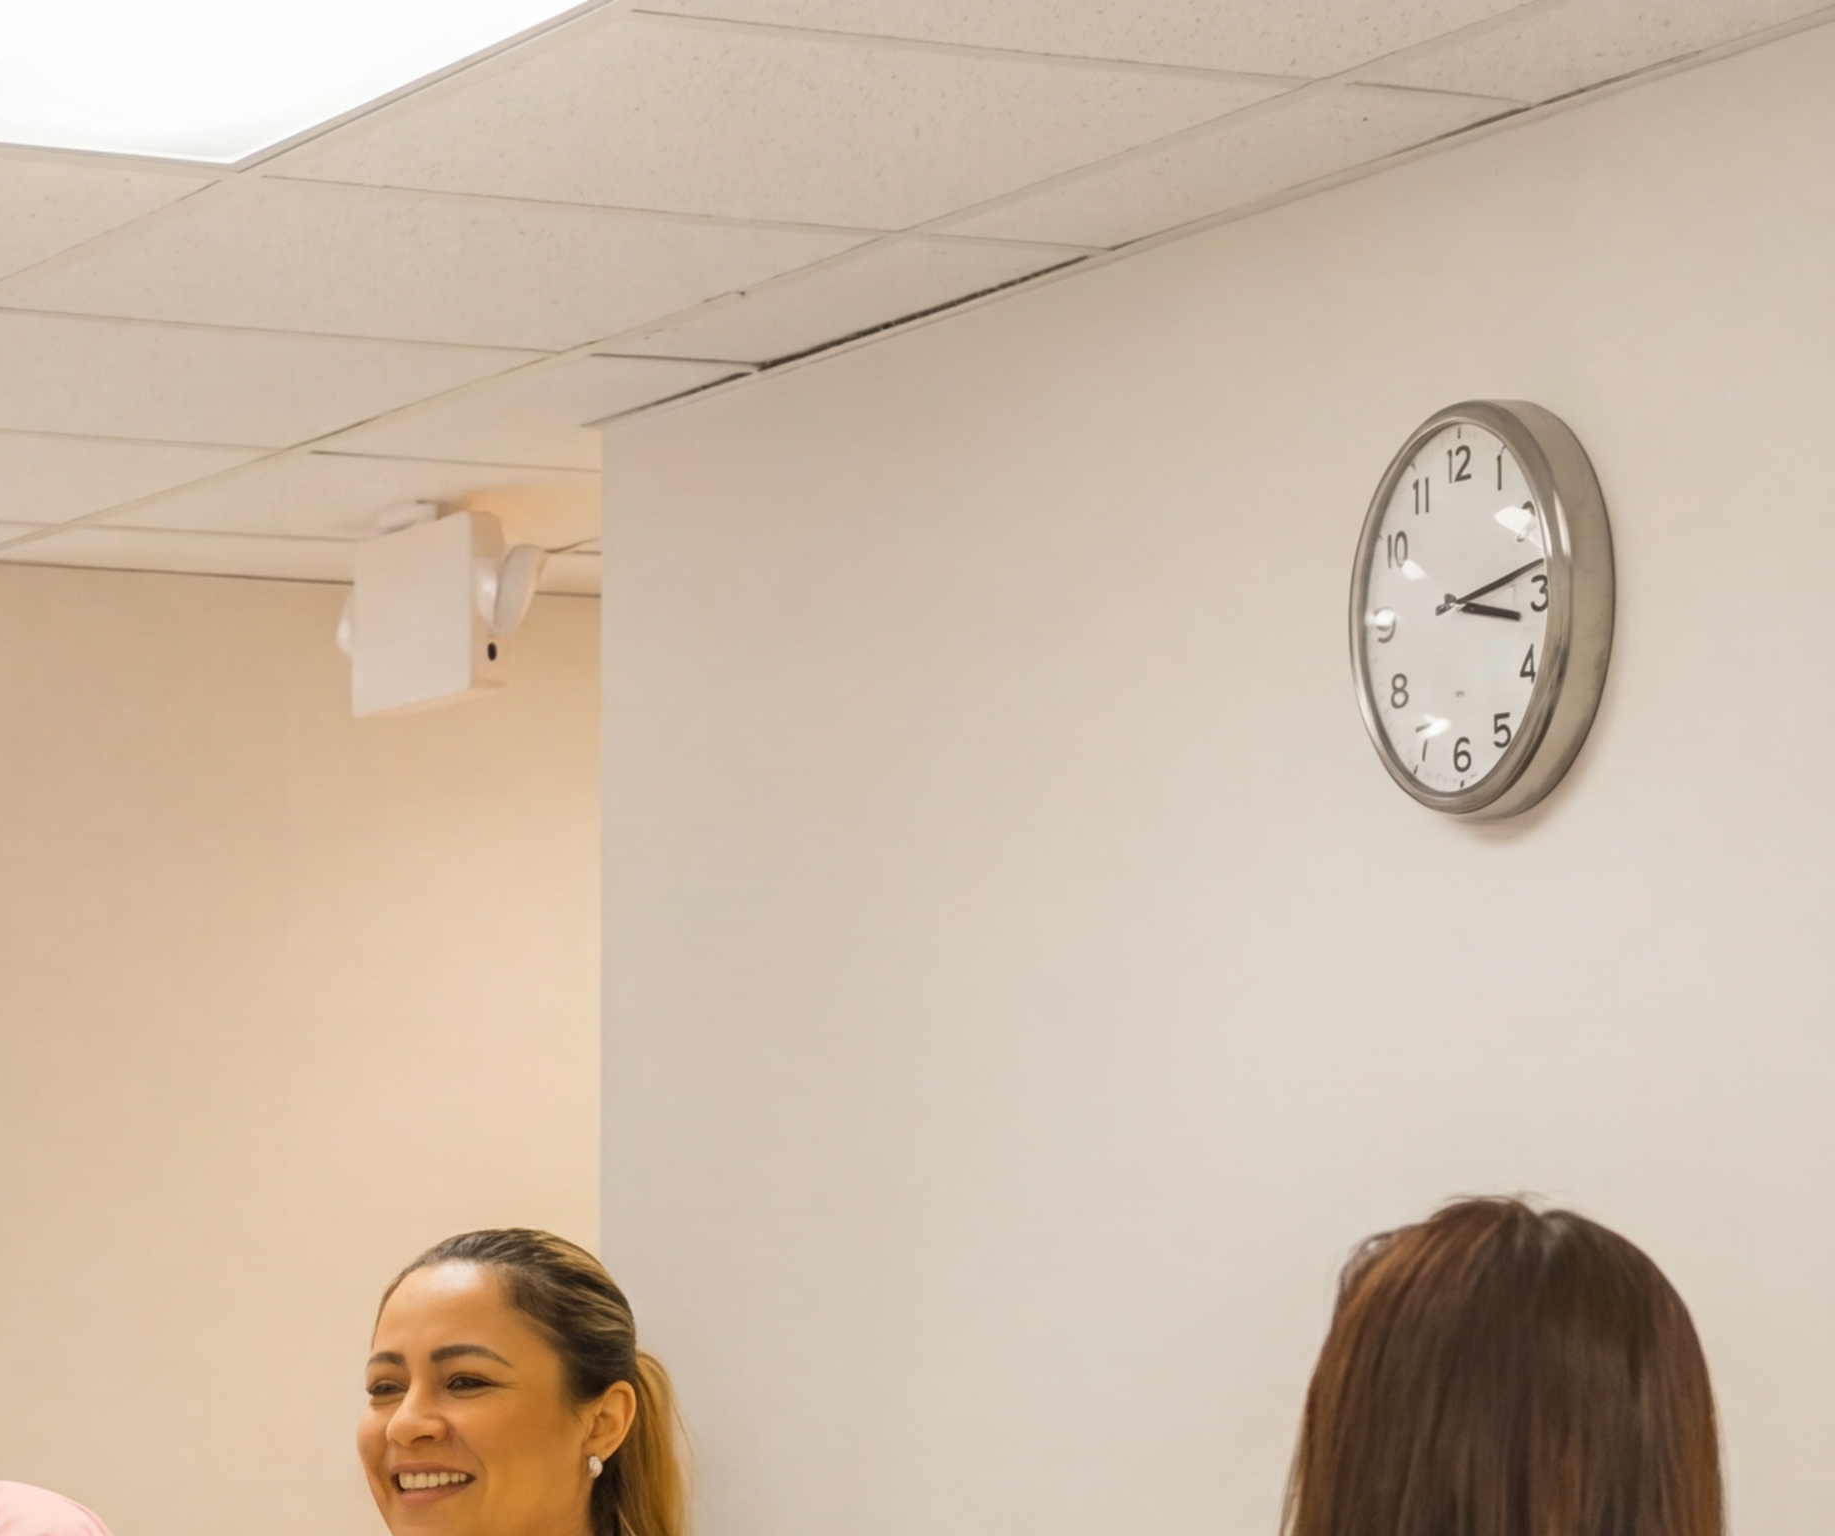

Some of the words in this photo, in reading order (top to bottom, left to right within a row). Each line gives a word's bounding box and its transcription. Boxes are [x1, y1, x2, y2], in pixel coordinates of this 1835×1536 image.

[1447, 445, 1472, 483] 12
[1496, 453, 1503, 491] 1
[1412, 476, 1430, 515] 11
[1387, 530, 1409, 568] 10
[1530, 574, 1549, 612] 3
[1374, 606, 1397, 644] 9
[1519, 643, 1537, 683] 4
[1390, 673, 1410, 708] 8
[1492, 712, 1512, 748] 5
[1452, 736, 1472, 773] 6
